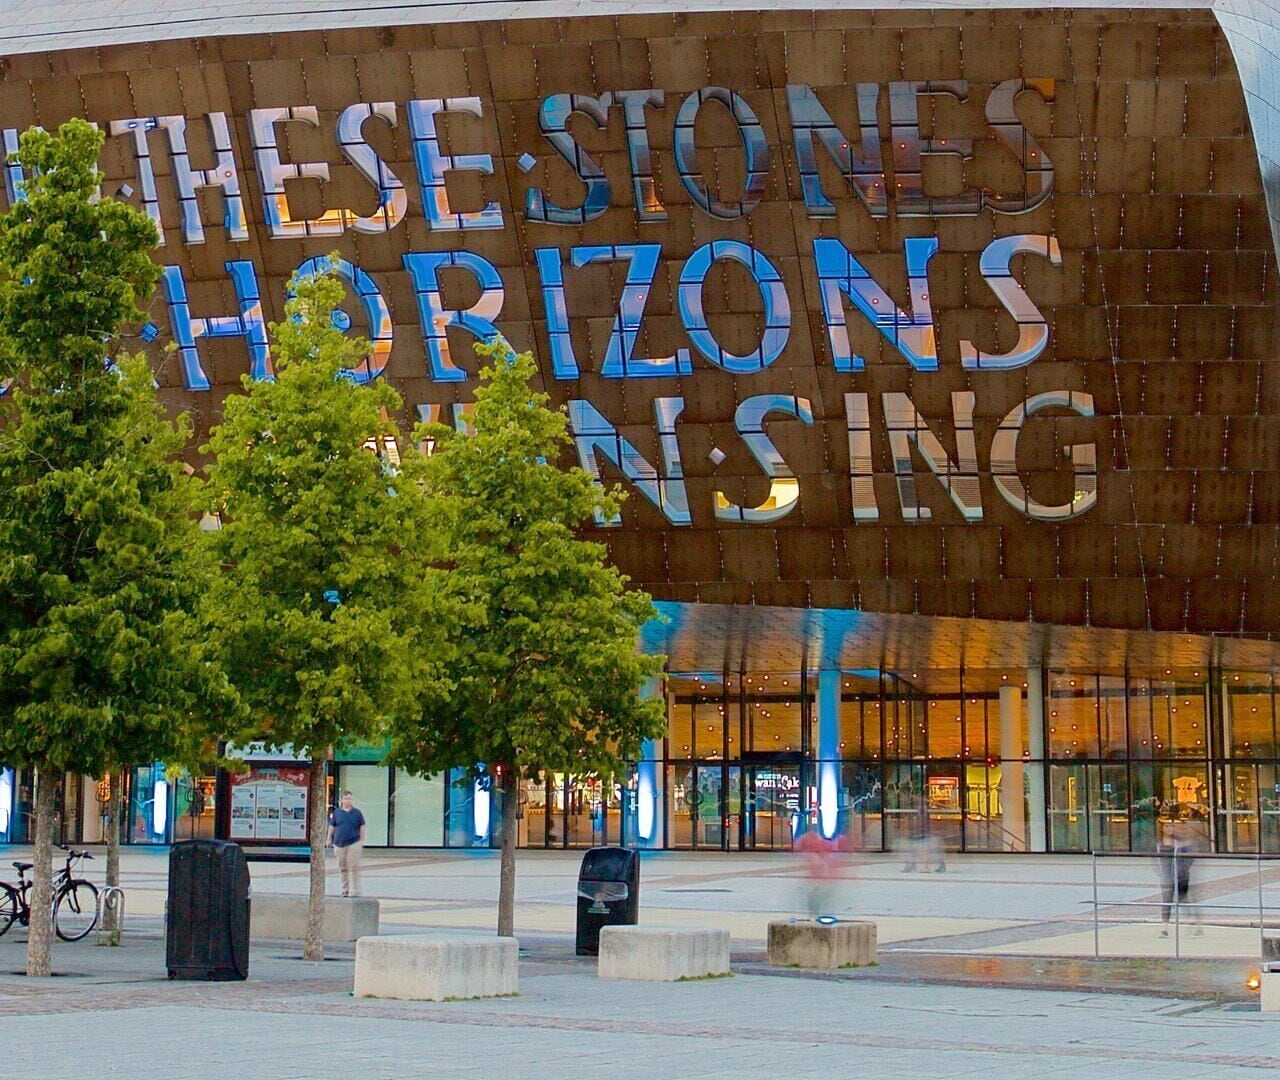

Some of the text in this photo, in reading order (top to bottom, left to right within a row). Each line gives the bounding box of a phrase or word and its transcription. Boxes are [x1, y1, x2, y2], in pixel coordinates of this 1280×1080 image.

[108, 94, 505, 248] THESE
[524, 76, 1057, 228] STONES
[161, 232, 1064, 393] HORIZONS
[712, 388, 1099, 522] SING
